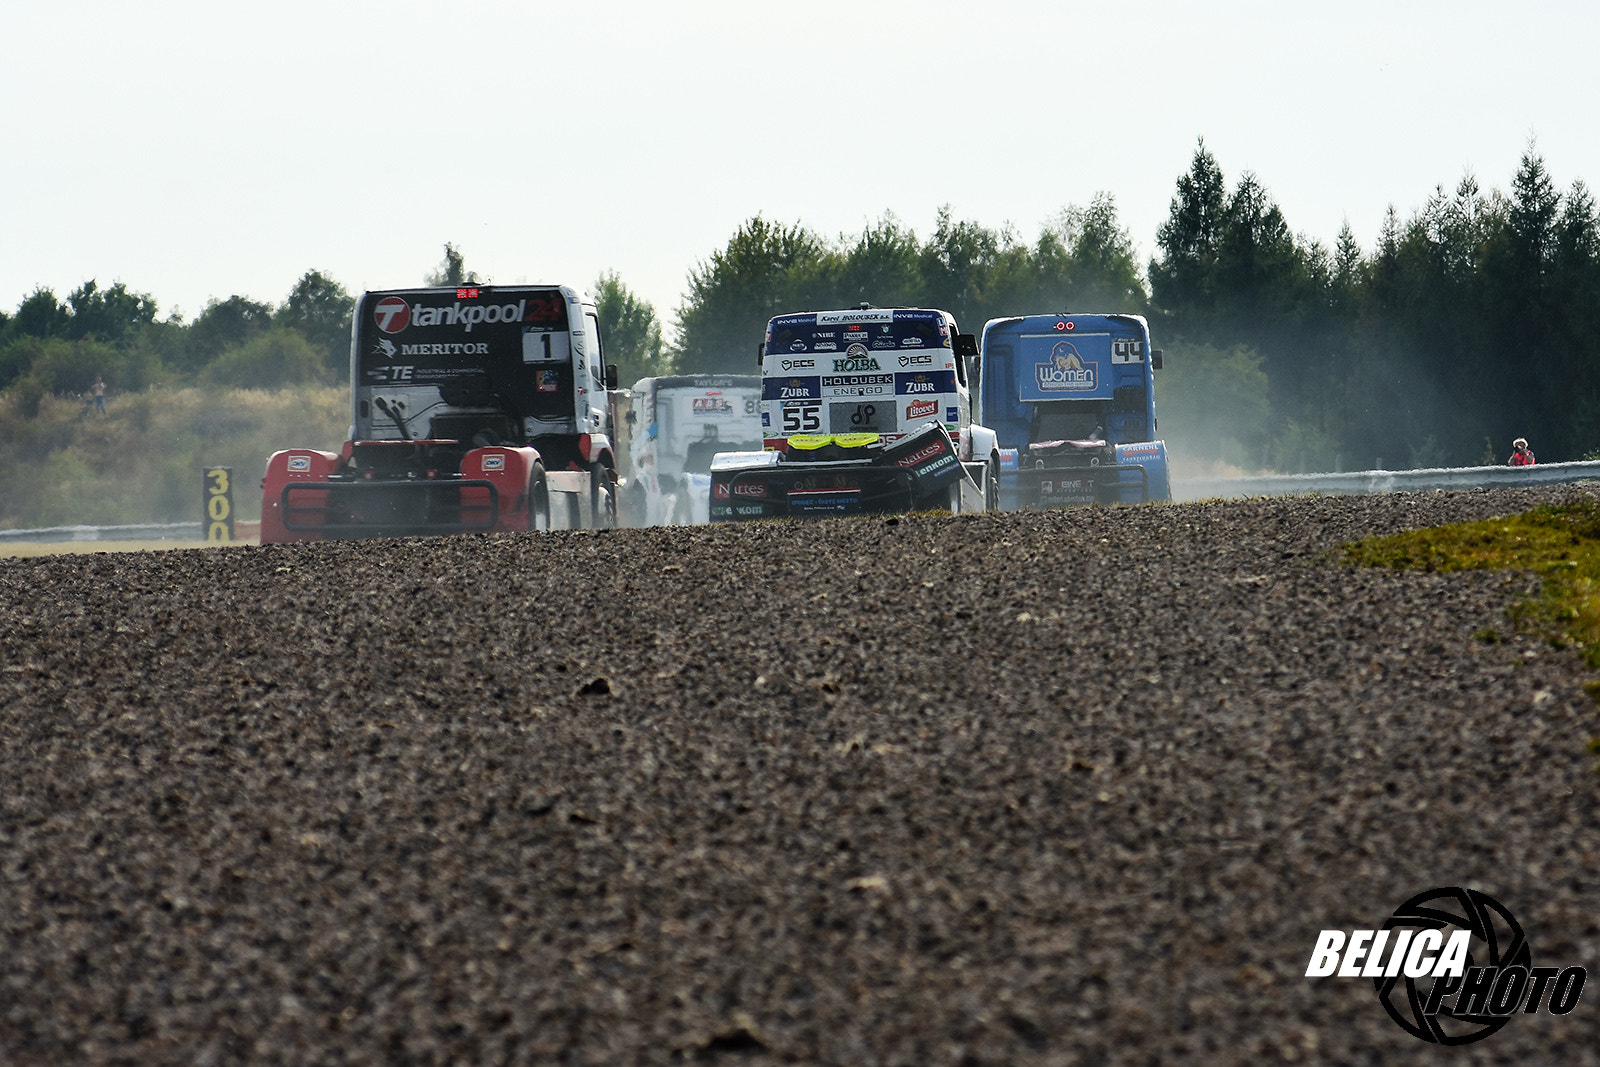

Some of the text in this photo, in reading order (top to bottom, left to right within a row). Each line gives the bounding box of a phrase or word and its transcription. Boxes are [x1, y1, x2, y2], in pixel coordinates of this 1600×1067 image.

[401, 342, 489, 355] MERITOR
[541, 334, 551, 359] 1
[1115, 343, 1144, 361] 44
[793, 359, 815, 368] ECS
[832, 358, 881, 373] HOLBA
[910, 355, 932, 364] ECS
[391, 365, 415, 380] TE
[823, 375, 893, 386] HOLOUBEK
[905, 382, 935, 393] ZUBR
[780, 387, 810, 398] ZUBR
[833, 387, 883, 396] ENERGO
[783, 407, 820, 431] 55
[898, 442, 941, 467] Nartes
[207, 469, 230, 544] 300
